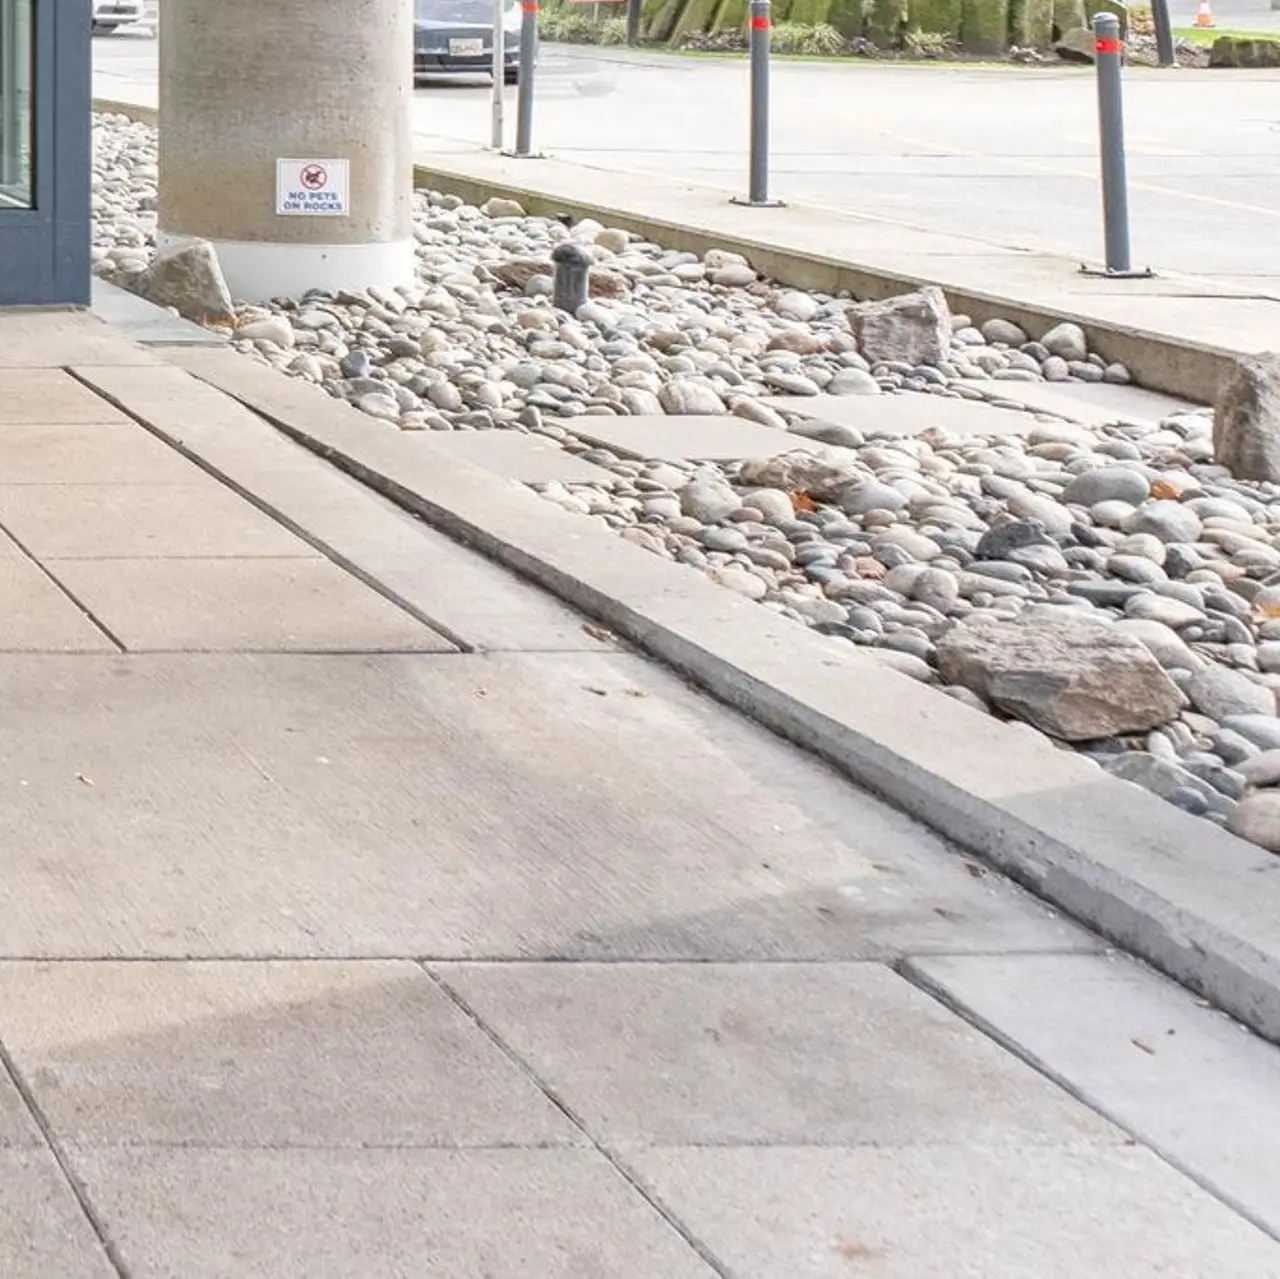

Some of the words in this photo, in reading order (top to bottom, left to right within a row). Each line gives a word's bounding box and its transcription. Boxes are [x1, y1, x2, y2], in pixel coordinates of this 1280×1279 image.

[288, 192, 306, 200] NO
[309, 192, 337, 200] PETS
[284, 201, 300, 210] ON
[304, 201, 342, 210] ROCKS
